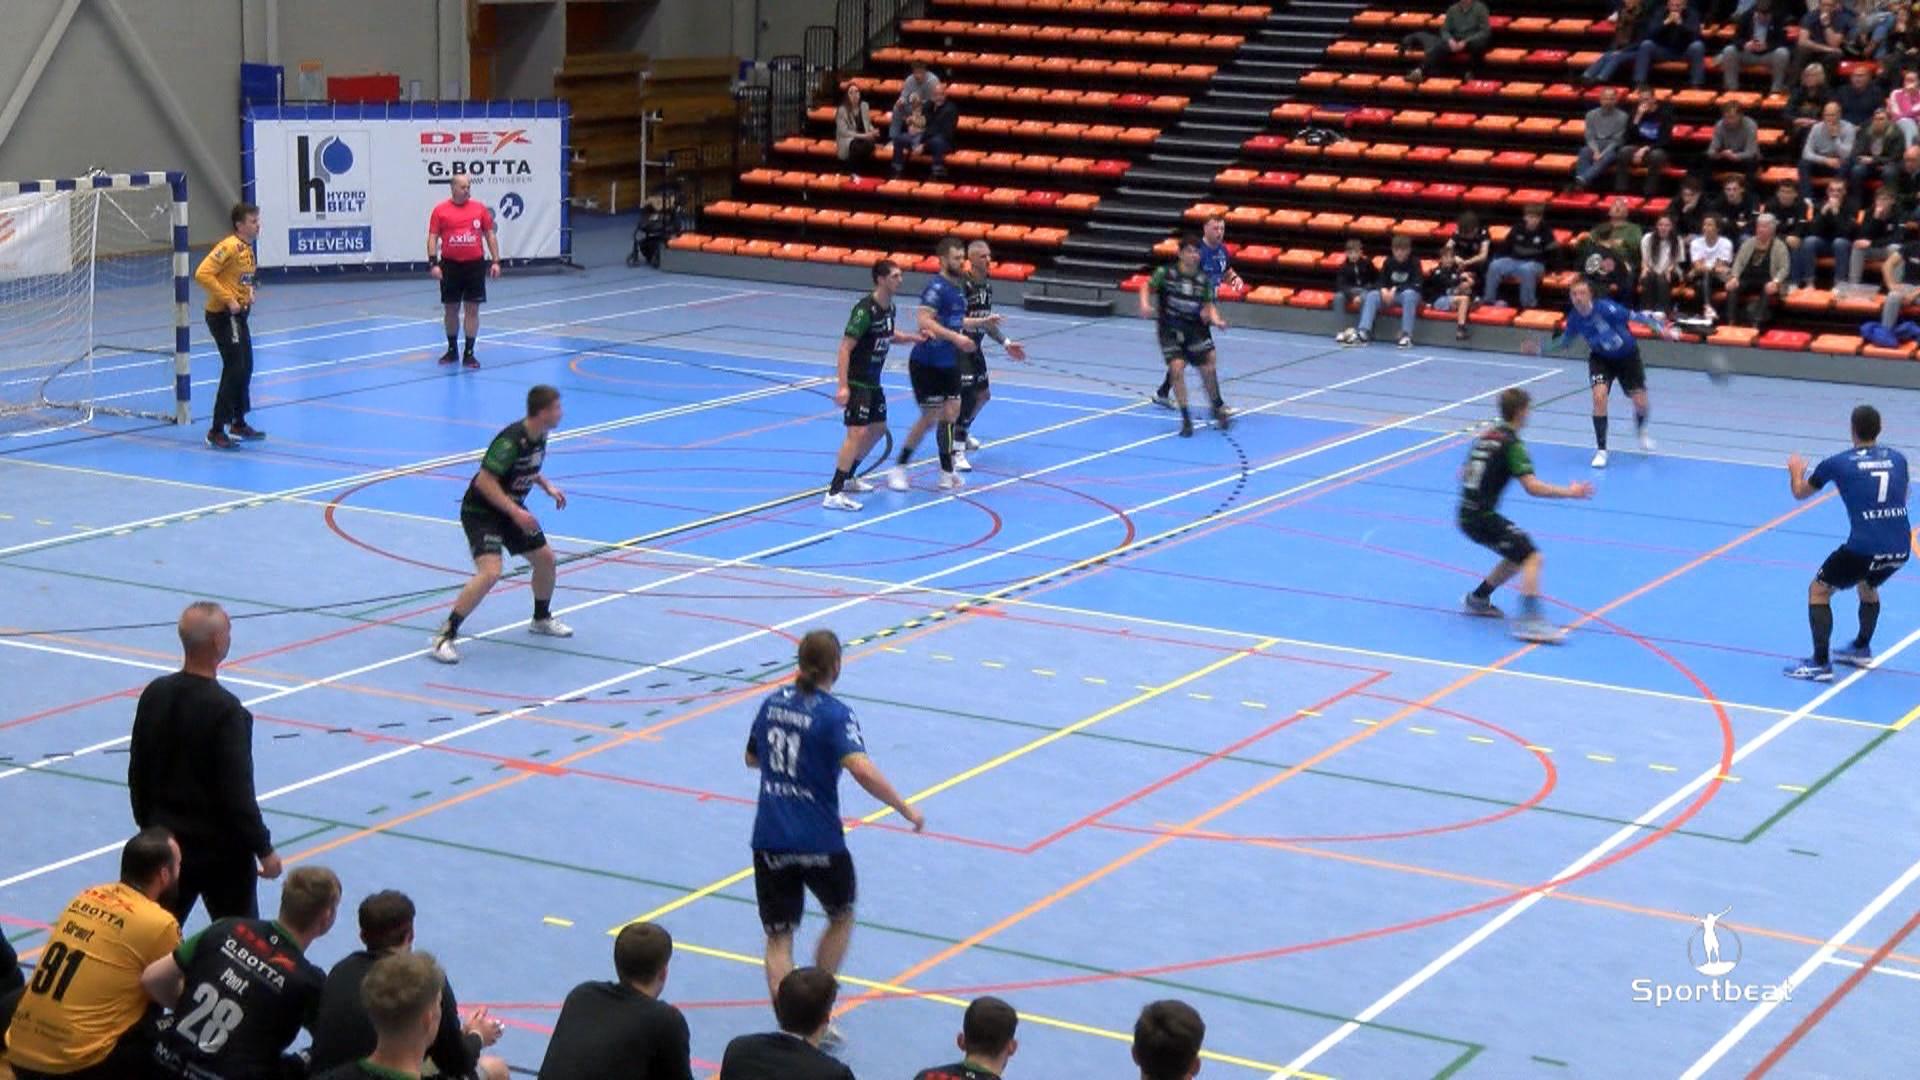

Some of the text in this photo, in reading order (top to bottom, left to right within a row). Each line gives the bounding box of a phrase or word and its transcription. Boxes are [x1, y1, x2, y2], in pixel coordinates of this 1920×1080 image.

[427, 160, 532, 176] G.BOTTA
[327, 191, 366, 200] HYDRO
[327, 200, 365, 213] BELT
[297, 237, 364, 251] STEVENS
[1871, 471, 1889, 503] 7
[31, 940, 86, 1002] 91
[224, 938, 286, 989] G.BOTTA
[176, 982, 244, 1053] 28
